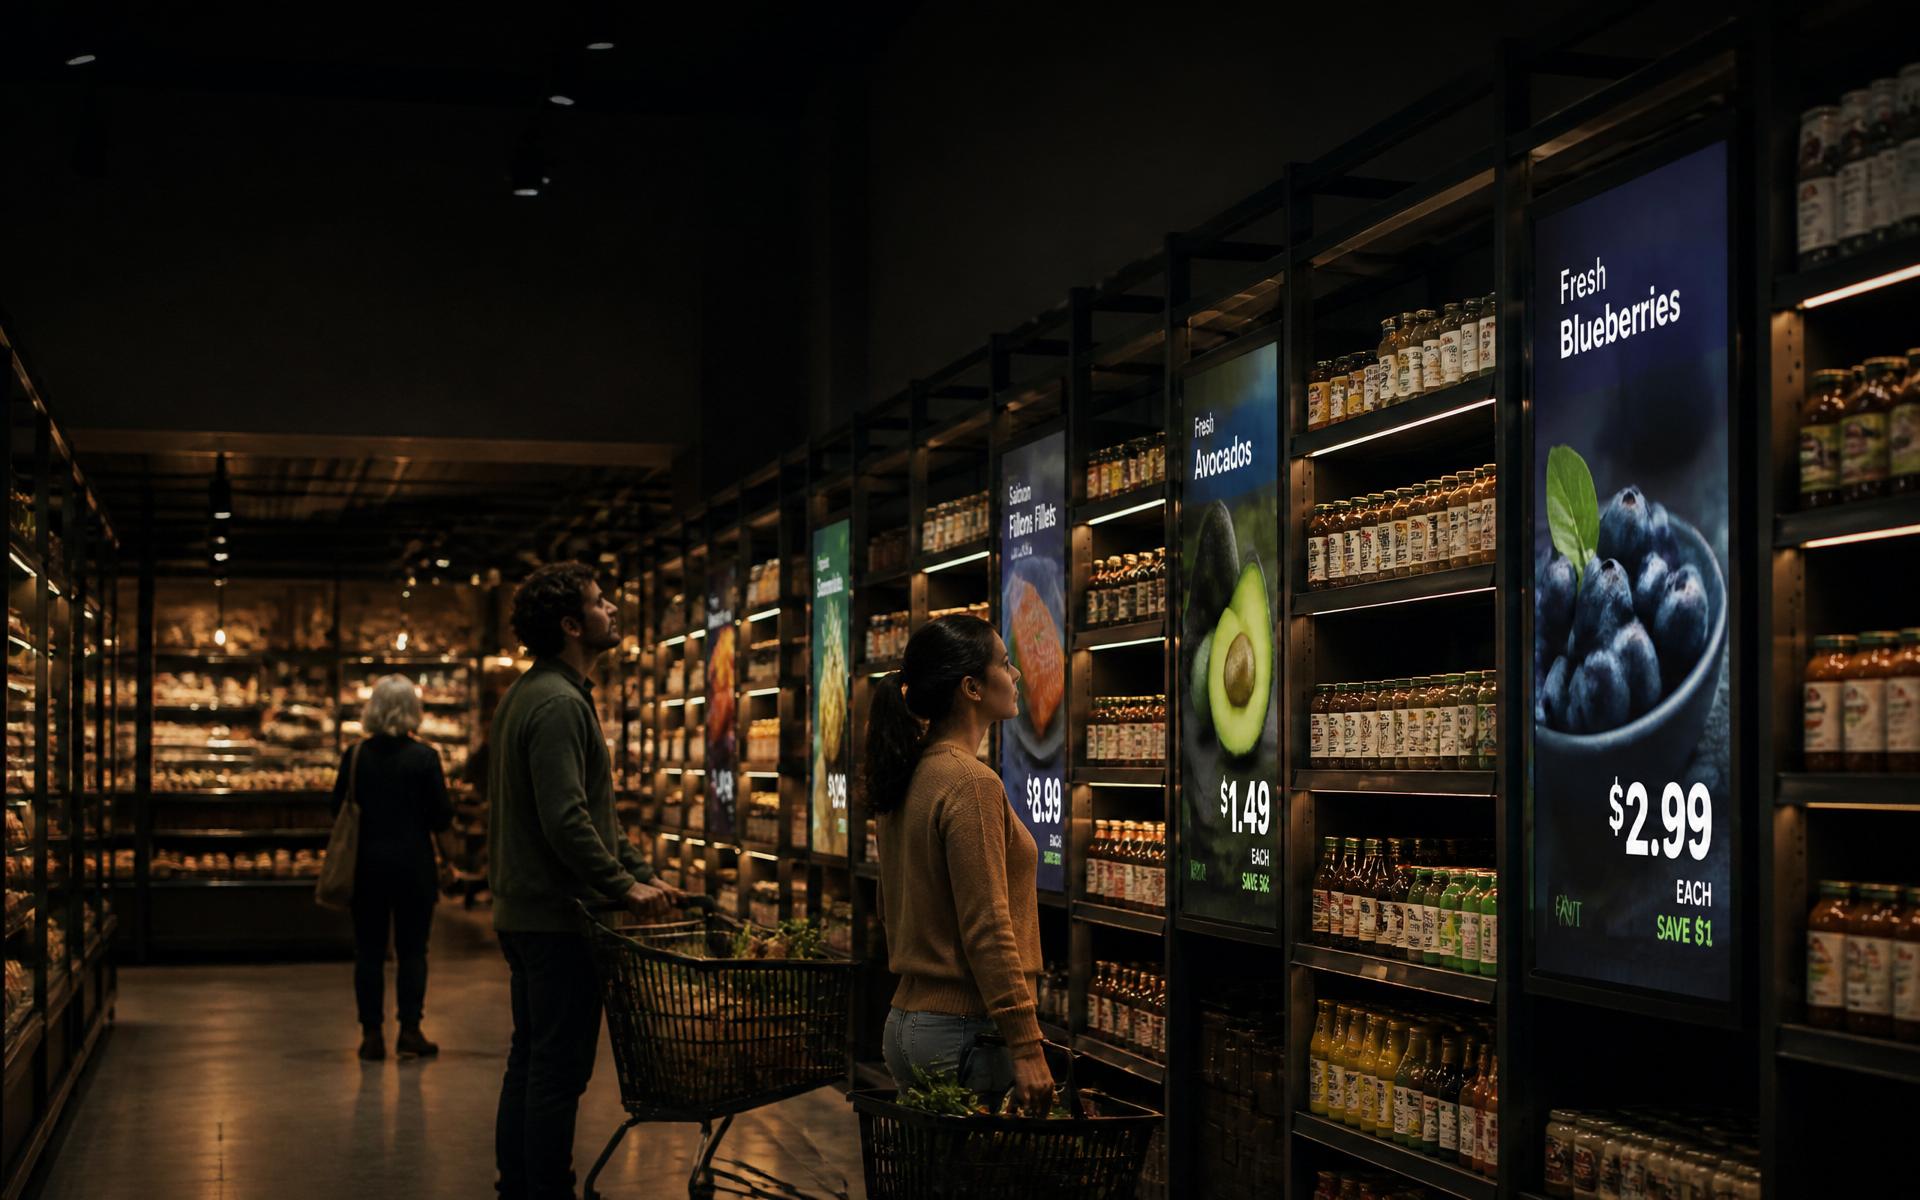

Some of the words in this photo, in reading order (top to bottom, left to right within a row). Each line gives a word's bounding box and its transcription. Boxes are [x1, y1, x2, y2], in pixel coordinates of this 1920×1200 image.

[1561, 256, 1606, 305] Fresh
[1561, 285, 1681, 359] Blueberries
[1194, 411, 1214, 438] Fresh
[1194, 435, 1252, 480] Avocados
[1026, 773, 1061, 824] $8.99
[1220, 775, 1270, 836] $1.49
[1608, 776, 1712, 860] $2.99
[1251, 848, 1270, 867] EACH
[1676, 879, 1712, 907] EACH
[1656, 914, 1690, 944] SAVE
[1695, 915, 1712, 947] $1
